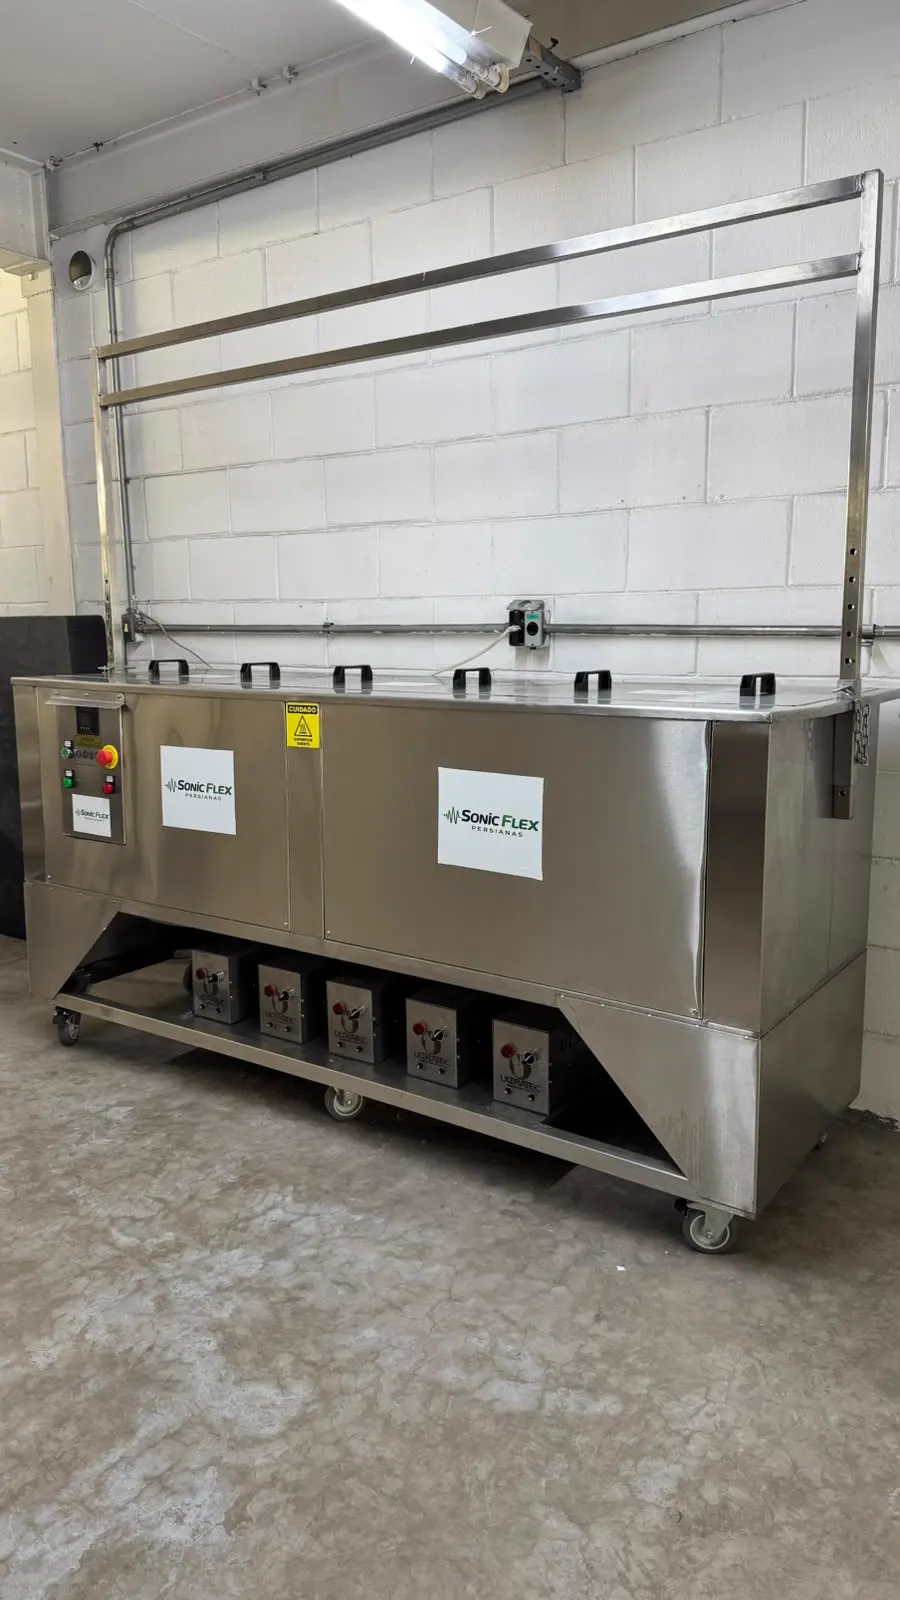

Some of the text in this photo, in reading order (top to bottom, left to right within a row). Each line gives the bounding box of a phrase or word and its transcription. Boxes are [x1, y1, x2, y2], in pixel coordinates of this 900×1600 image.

[288, 705, 317, 713] CUIDADO
[206, 783, 232, 795] FLEX
[185, 793, 221, 802] PERSIANAS
[501, 814, 539, 832] FLEX
[471, 825, 523, 838] PERSIANAS
